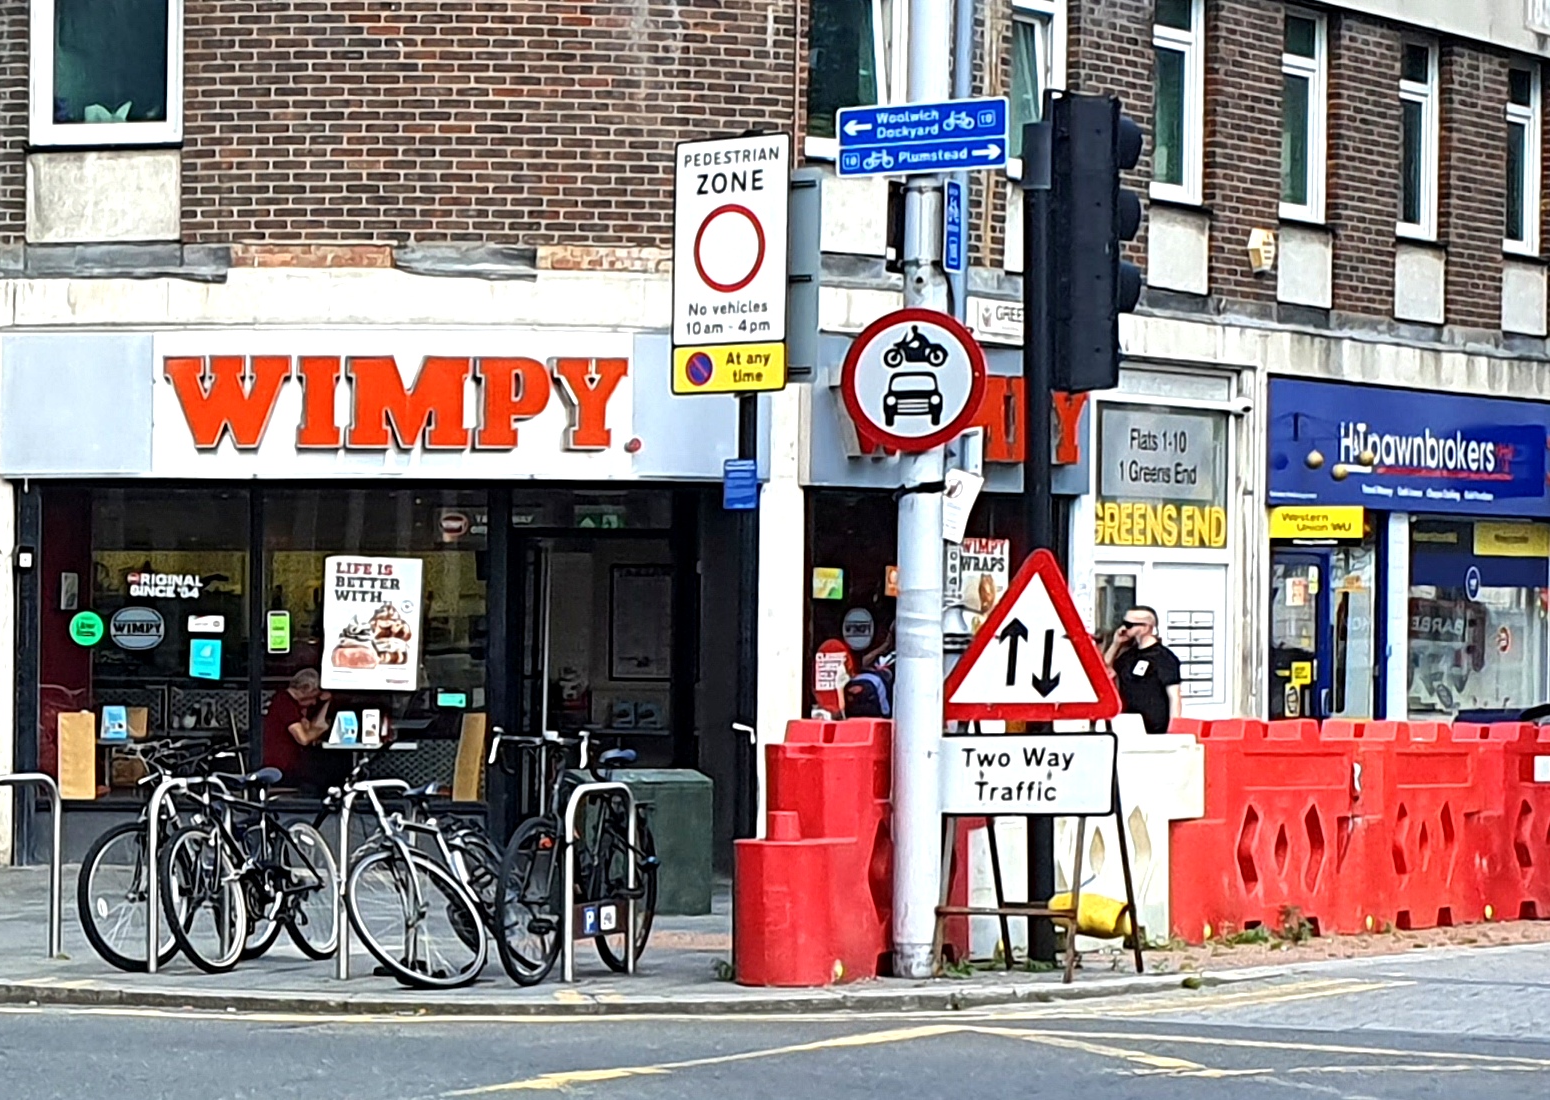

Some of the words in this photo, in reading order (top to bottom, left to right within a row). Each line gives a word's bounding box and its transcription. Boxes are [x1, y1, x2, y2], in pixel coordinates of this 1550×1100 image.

[876, 109, 939, 124] Woolwich
[876, 123, 939, 139] Dockyard
[684, 146, 779, 168] PEDESTRIAN
[899, 147, 968, 163] Plumstead
[696, 169, 764, 196] ZONE
[688, 303, 707, 317] No
[712, 300, 768, 315] vehicles
[726, 351, 741, 366] At
[746, 353, 771, 367] any
[733, 369, 763, 383] time
[163, 356, 630, 449] WIMPY
[1130, 428, 1158, 451] Flats
[1162, 431, 1187, 453] 1-10
[1119, 460, 1125, 481] 1
[1129, 460, 1171, 484] Greens
[1174, 462, 1197, 485] End
[1095, 502, 1178, 546] GREENS
[1181, 505, 1226, 547] END
[336, 562, 372, 575] LIFE
[377, 563, 393, 576] IS
[961, 556, 1005, 572] WRAPS
[335, 576, 400, 590] BETTER
[113, 622, 161, 634] WIMPY
[961, 748, 1011, 767] Two
[1023, 747, 1075, 771] Way
[974, 781, 1057, 801] Traffic
